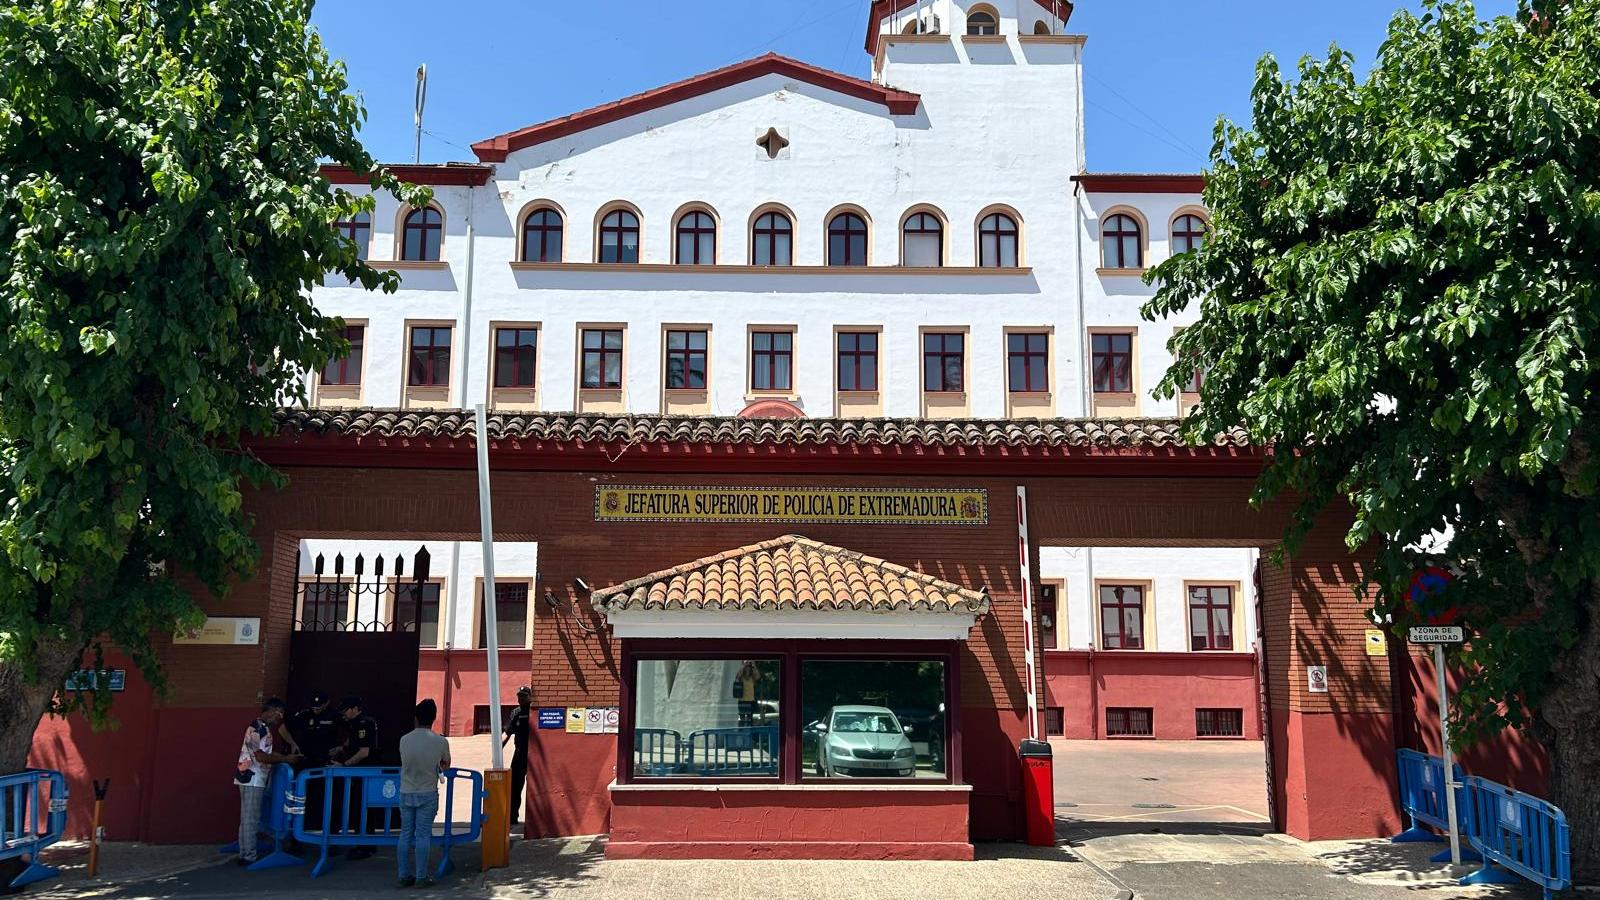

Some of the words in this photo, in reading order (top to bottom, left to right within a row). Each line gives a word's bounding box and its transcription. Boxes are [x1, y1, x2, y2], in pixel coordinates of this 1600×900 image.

[624, 493, 690, 514] JEFATURA
[694, 493, 759, 514] SUPERIOR
[763, 494, 780, 515] DE
[783, 494, 834, 516] POLICIA
[838, 495, 855, 516] DE
[859, 495, 957, 516] EXTREMADURA
